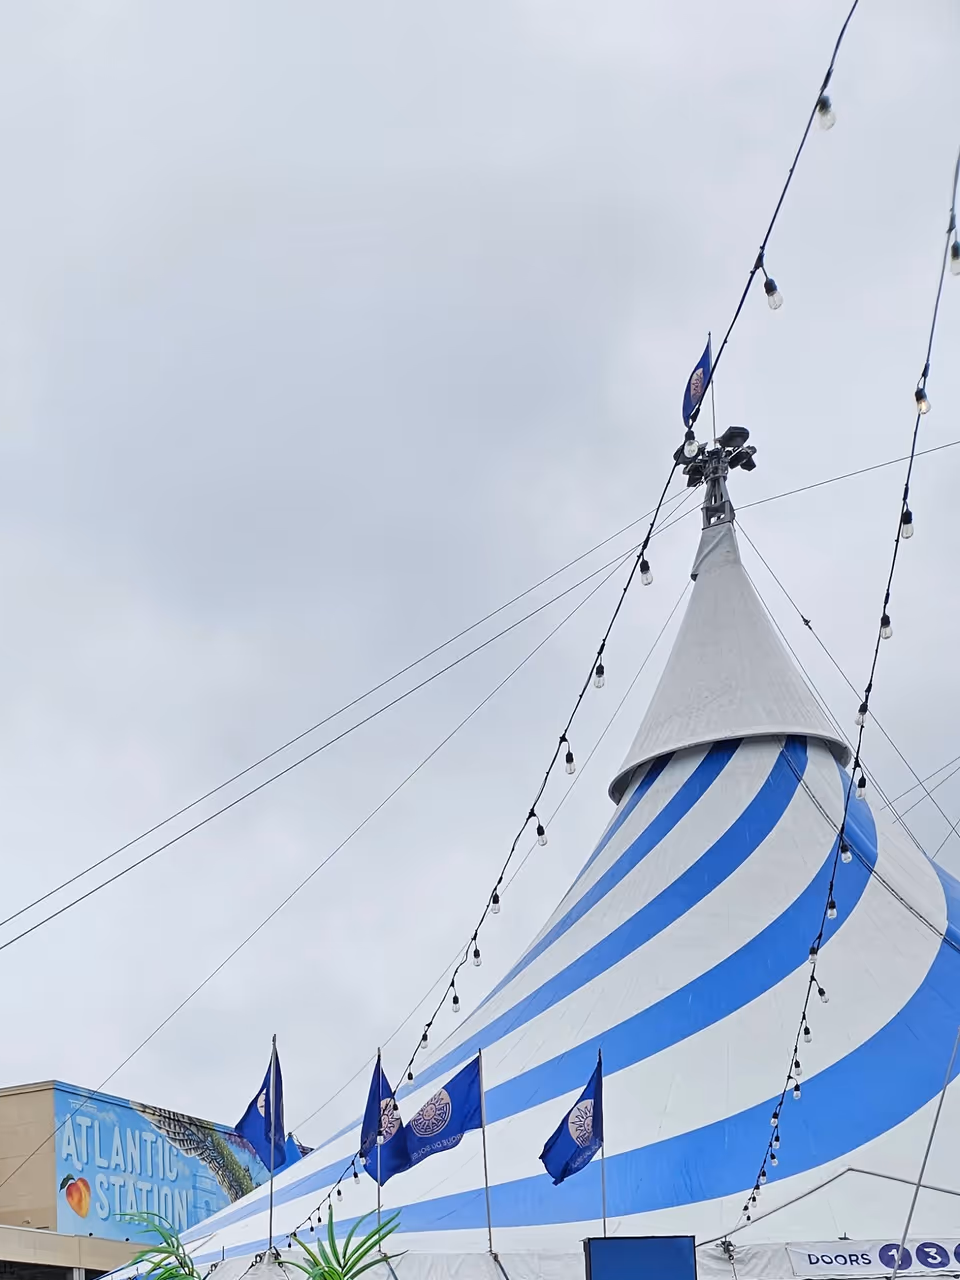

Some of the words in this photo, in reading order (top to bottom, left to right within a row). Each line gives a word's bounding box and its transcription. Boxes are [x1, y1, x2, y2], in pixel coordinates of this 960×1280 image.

[61, 1113, 179, 1181] ATLANTIC
[95, 1173, 188, 1231] STATION
[807, 1253, 872, 1266] DOORS
[923, 1247, 942, 1264] 3
